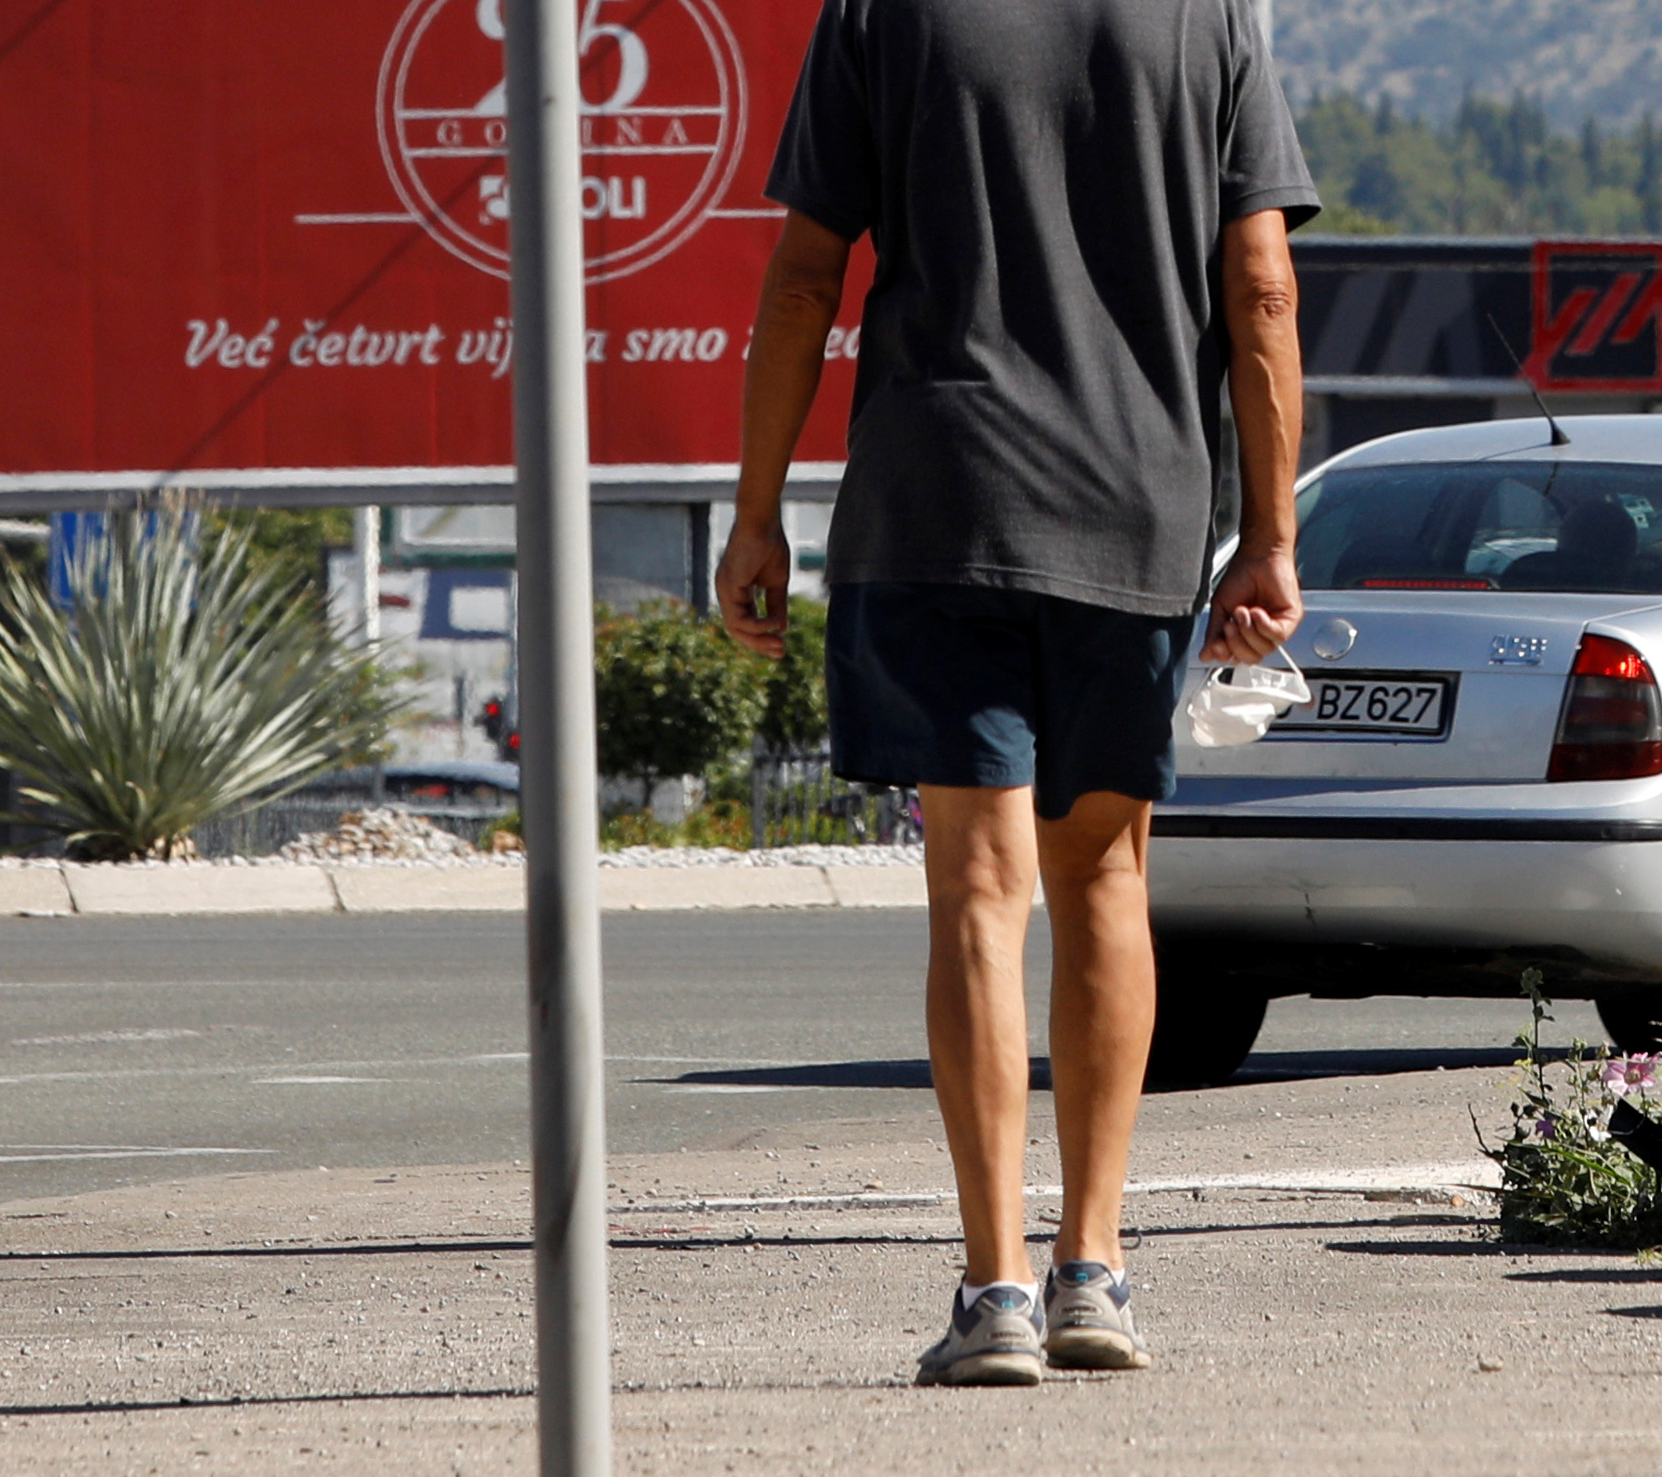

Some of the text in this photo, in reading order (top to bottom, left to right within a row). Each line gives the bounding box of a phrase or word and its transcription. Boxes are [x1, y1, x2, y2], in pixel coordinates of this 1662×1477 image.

[438, 116, 688, 147] GOINA
[185, 317, 280, 369] Već
[289, 318, 445, 367] četvrt
[620, 326, 729, 363] smo
[1317, 683, 1438, 724] BZ627
